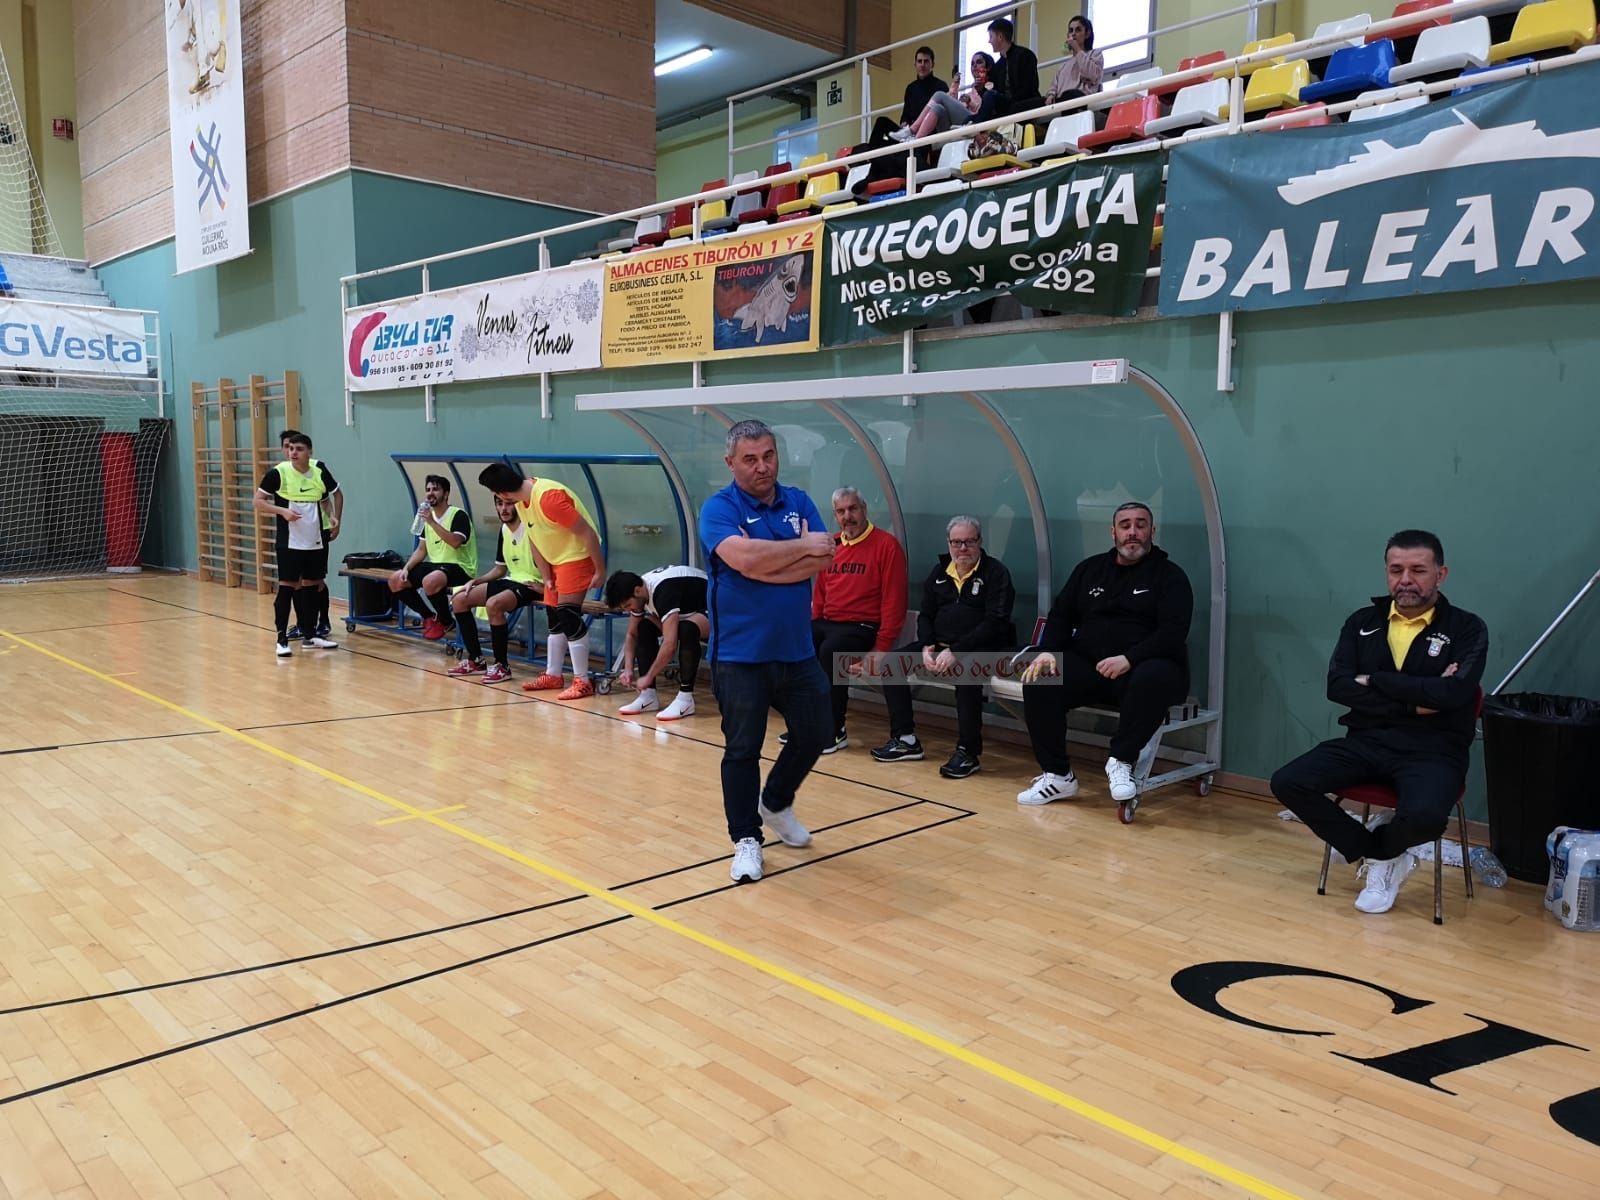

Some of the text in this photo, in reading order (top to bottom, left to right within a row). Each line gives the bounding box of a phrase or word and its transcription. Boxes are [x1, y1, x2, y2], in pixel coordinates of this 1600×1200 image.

[831, 173, 1139, 276] MUECOCEUTA
[610, 232, 814, 279] ALMACENES TIBURÓN 1 Y 2
[609, 271, 704, 292] EUROBUSINESS CEUTA, S.L.
[717, 263, 774, 280] TIBURÓN 1
[841, 268, 952, 303] Muebles
[968, 264, 985, 283] y
[1009, 240, 1119, 272] Cocina
[650, 308, 680, 317] AUXILIARES
[660, 295, 684, 303] MENAJE
[423, 314, 454, 344] TUR
[477, 293, 518, 338] Venus
[527, 312, 574, 364] Fitness
[369, 367, 381, 376] 956
[410, 362, 423, 371] 609
